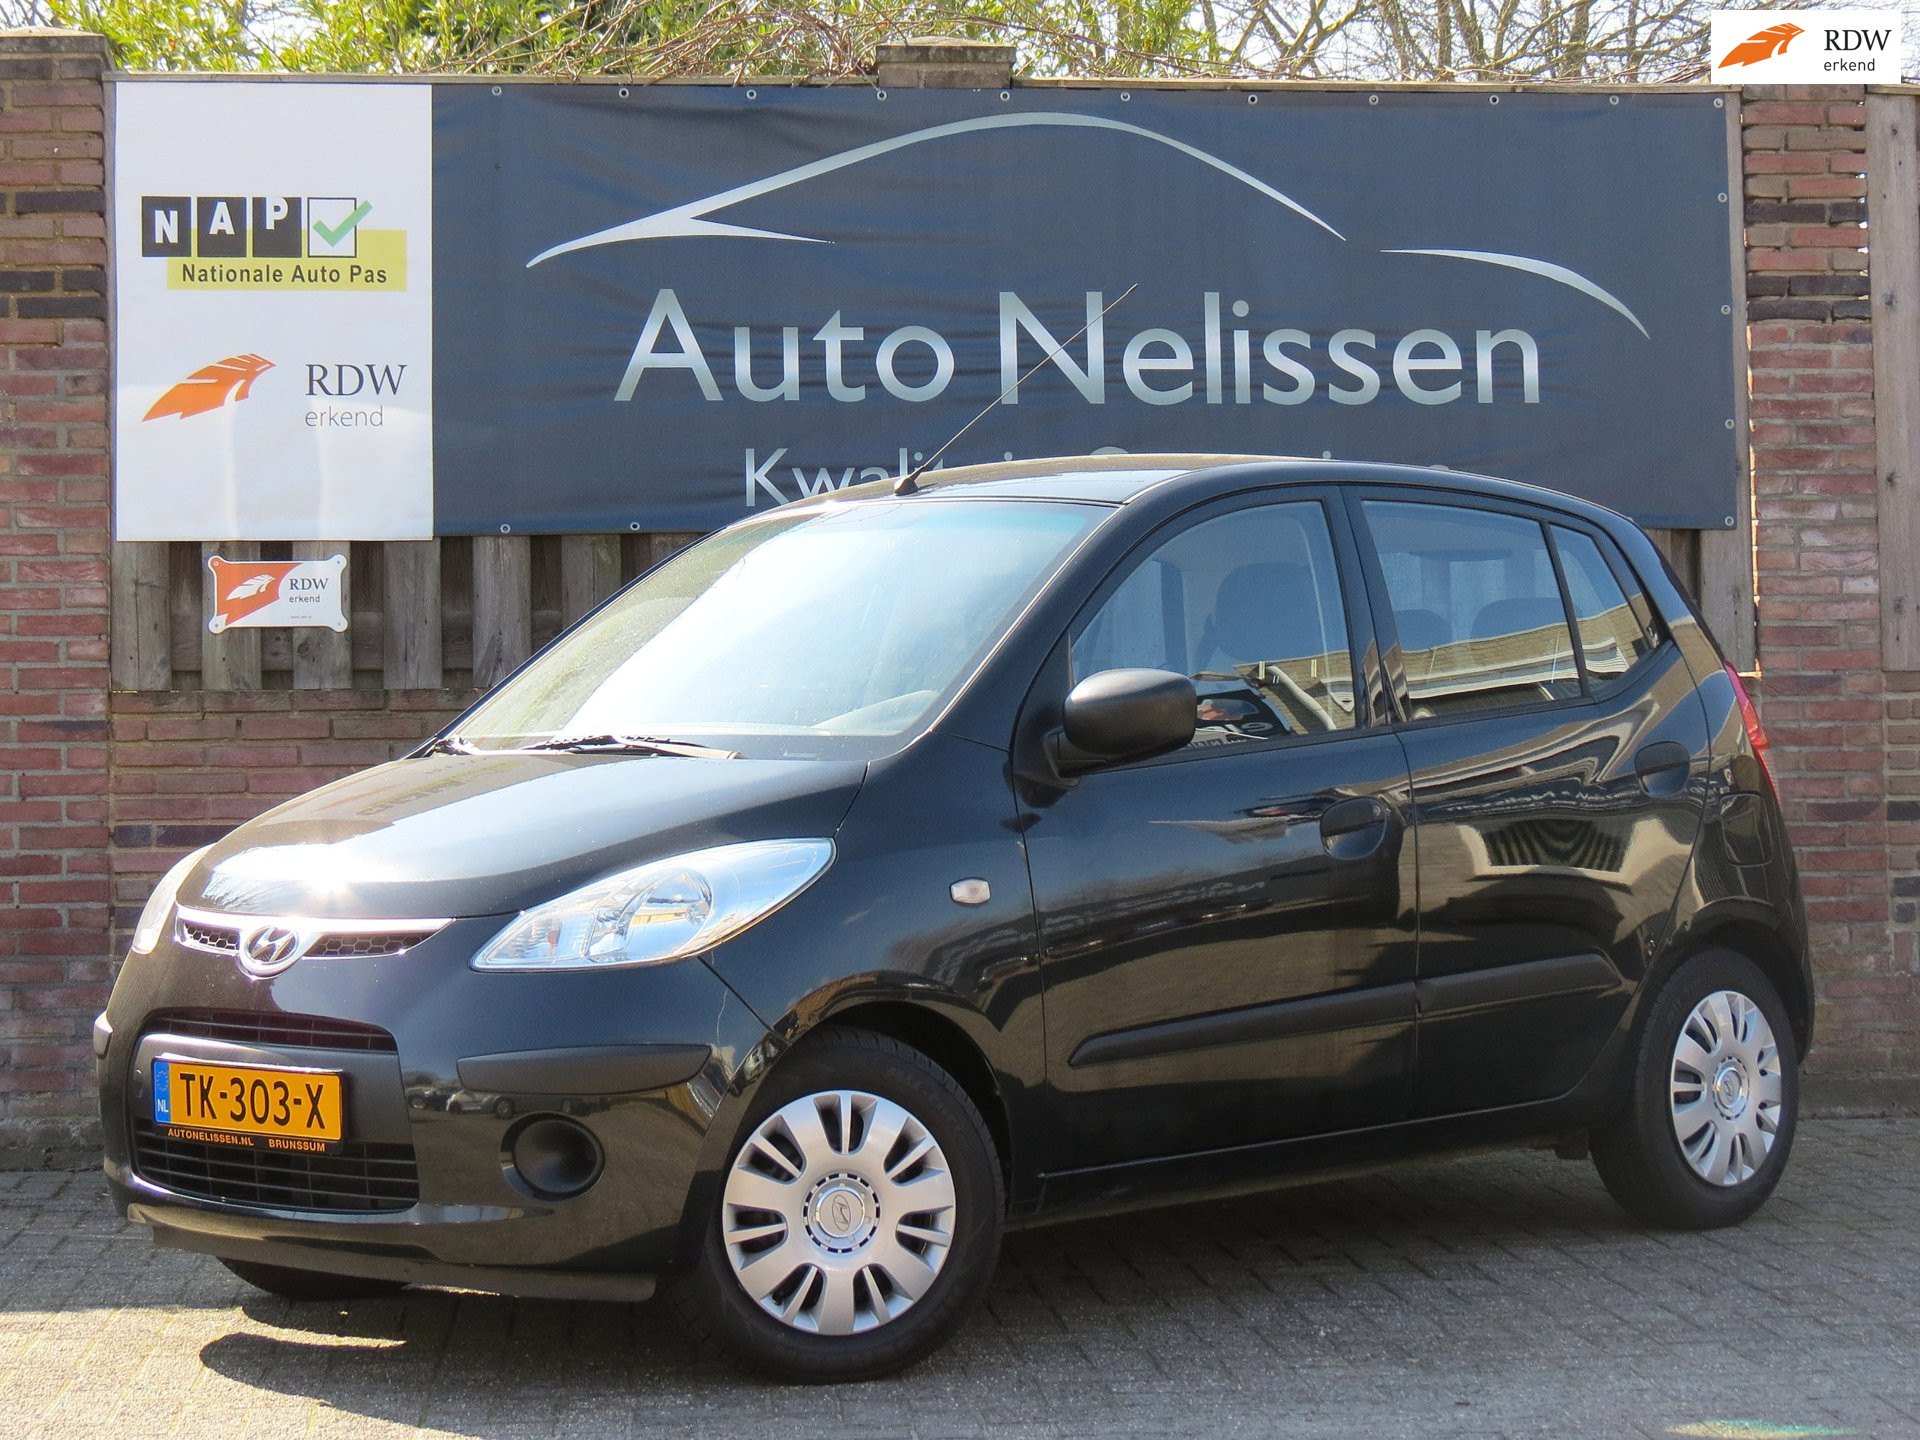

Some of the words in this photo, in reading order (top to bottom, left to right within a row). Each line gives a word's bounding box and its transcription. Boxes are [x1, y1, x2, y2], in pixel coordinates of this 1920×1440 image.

[182, 264, 284, 284] Nationale
[291, 264, 341, 284] Auto
[350, 265, 388, 284] Pas
[613, 288, 955, 403] Auto
[999, 290, 1541, 406] Nelissen
[305, 364, 408, 396] RDW
[305, 406, 383, 427] erkend
[289, 577, 329, 591] RDW
[289, 594, 321, 603] erkend
[157, 1100, 169, 1113] NL
[179, 1072, 326, 1130] TK-303-X
[167, 1128, 254, 1147] AUTONELISSEN.NL
[268, 1138, 326, 1152] BRUNSSUM
